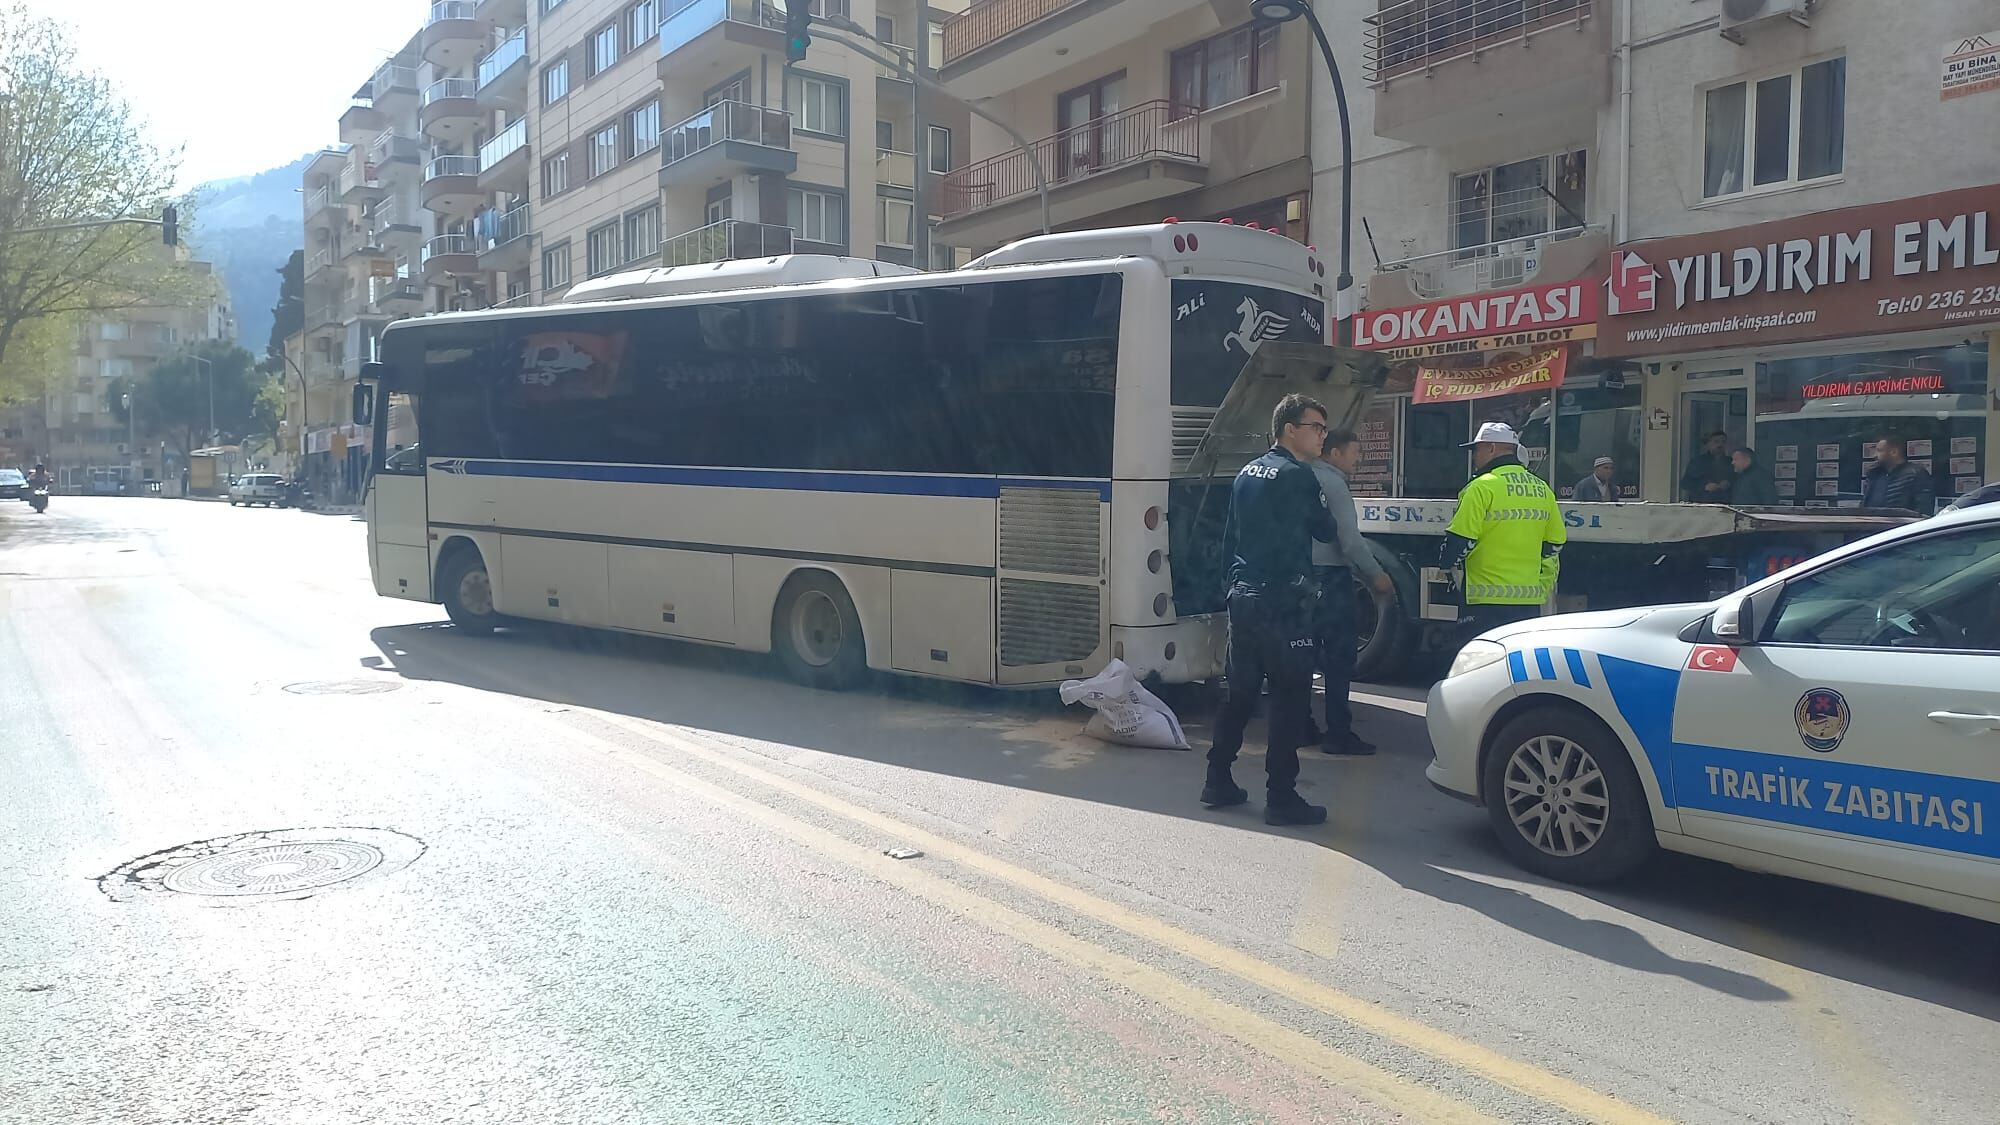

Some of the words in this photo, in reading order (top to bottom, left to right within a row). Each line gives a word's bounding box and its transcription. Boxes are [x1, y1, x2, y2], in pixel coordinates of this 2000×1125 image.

[1949, 62, 1965, 72] BU
[1668, 228, 1872, 310] YILDIRIM
[1927, 289, 1966, 310] 236
[1301, 307, 1321, 335] ARDA
[1354, 285, 1581, 346] LOKANTASI
[1427, 339, 1479, 355] YEMEK
[1494, 328, 1573, 347] TABLDOT
[1801, 382, 1851, 398] YILDIRIM
[1823, 781, 1984, 836] ZABITASI
